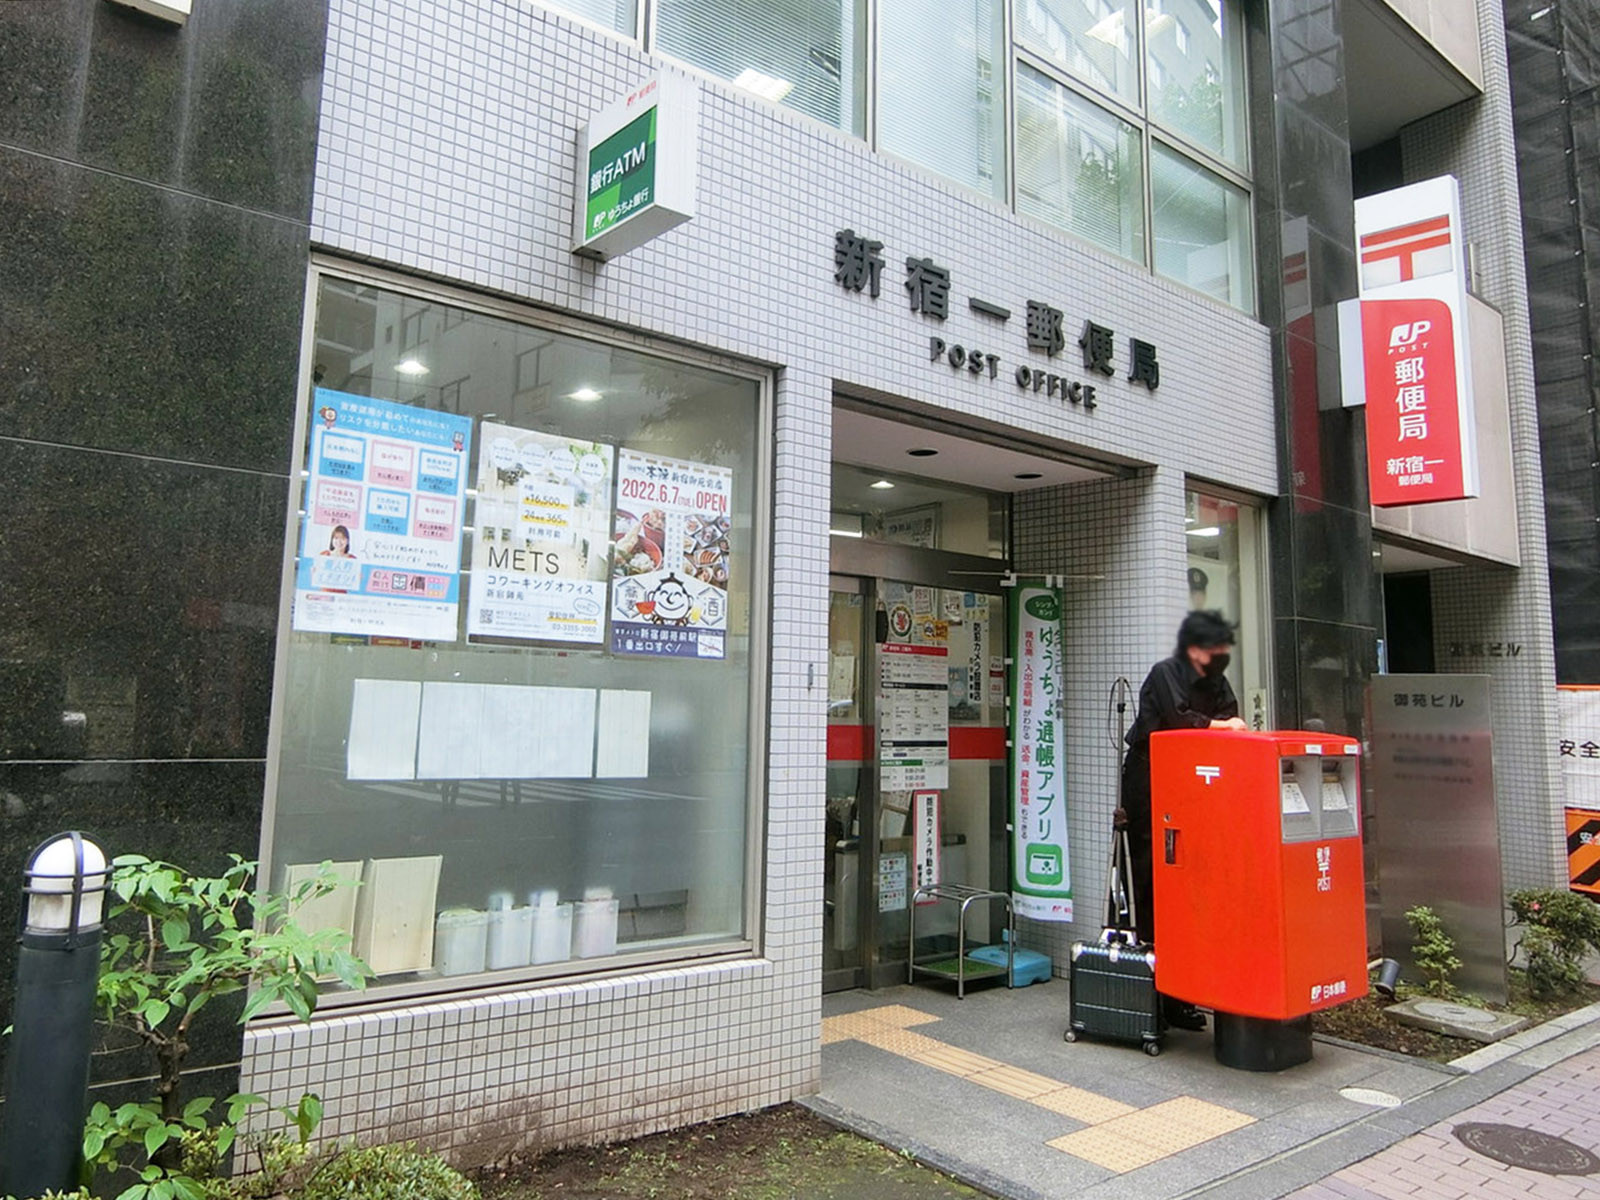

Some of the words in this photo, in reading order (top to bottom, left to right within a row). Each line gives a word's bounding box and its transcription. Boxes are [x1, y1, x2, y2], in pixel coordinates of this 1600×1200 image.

[590, 141, 646, 194] 銀行ATM
[607, 187, 649, 222] ゆうちょ銀行
[833, 228, 1161, 391] 新宿一郵便局
[1388, 342, 1429, 355] POST
[929, 336, 1000, 380] POST
[1015, 364, 1098, 409] OFFICE
[1395, 356, 1428, 442] 郵便局
[1386, 456, 1444, 476] 新宿一
[1398, 474, 1433, 485] 郵便局
[621, 478, 680, 504] 2022.6.7
[696, 491, 727, 512] OPEN
[488, 546, 559, 574] METS
[487, 575, 593, 595] コワーキングオフィス
[1393, 693, 1464, 708] 御苑ビル
[1035, 626, 1056, 841] ゆうちょ通帳アプリ
